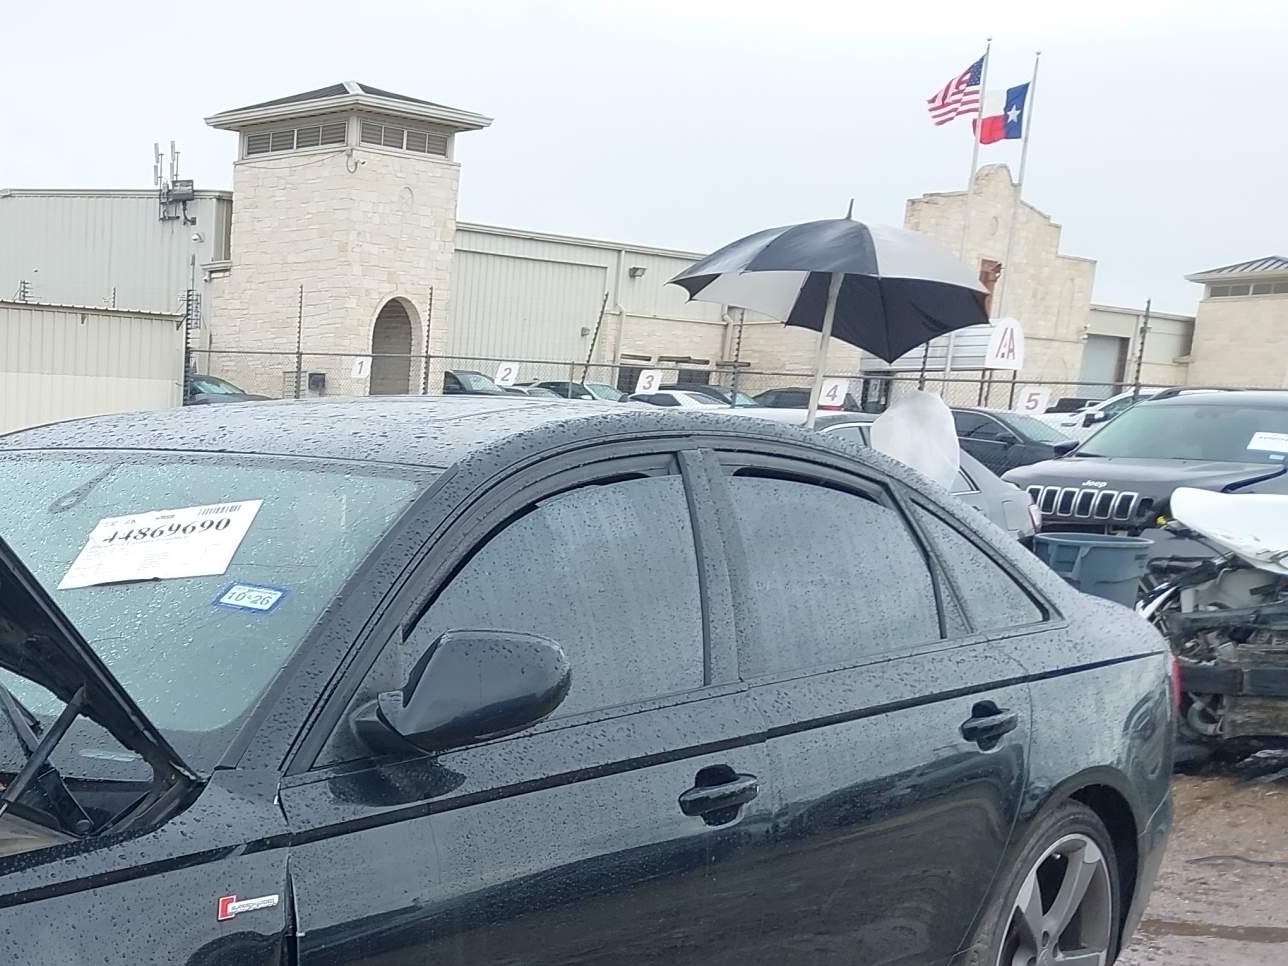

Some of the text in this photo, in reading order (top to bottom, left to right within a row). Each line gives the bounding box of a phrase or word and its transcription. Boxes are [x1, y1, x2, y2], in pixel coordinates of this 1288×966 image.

[358, 360, 364, 375] 1
[501, 367, 512, 381] 2
[642, 374, 654, 390] 3
[825, 384, 838, 401] 4
[1025, 392, 1041, 410] 5
